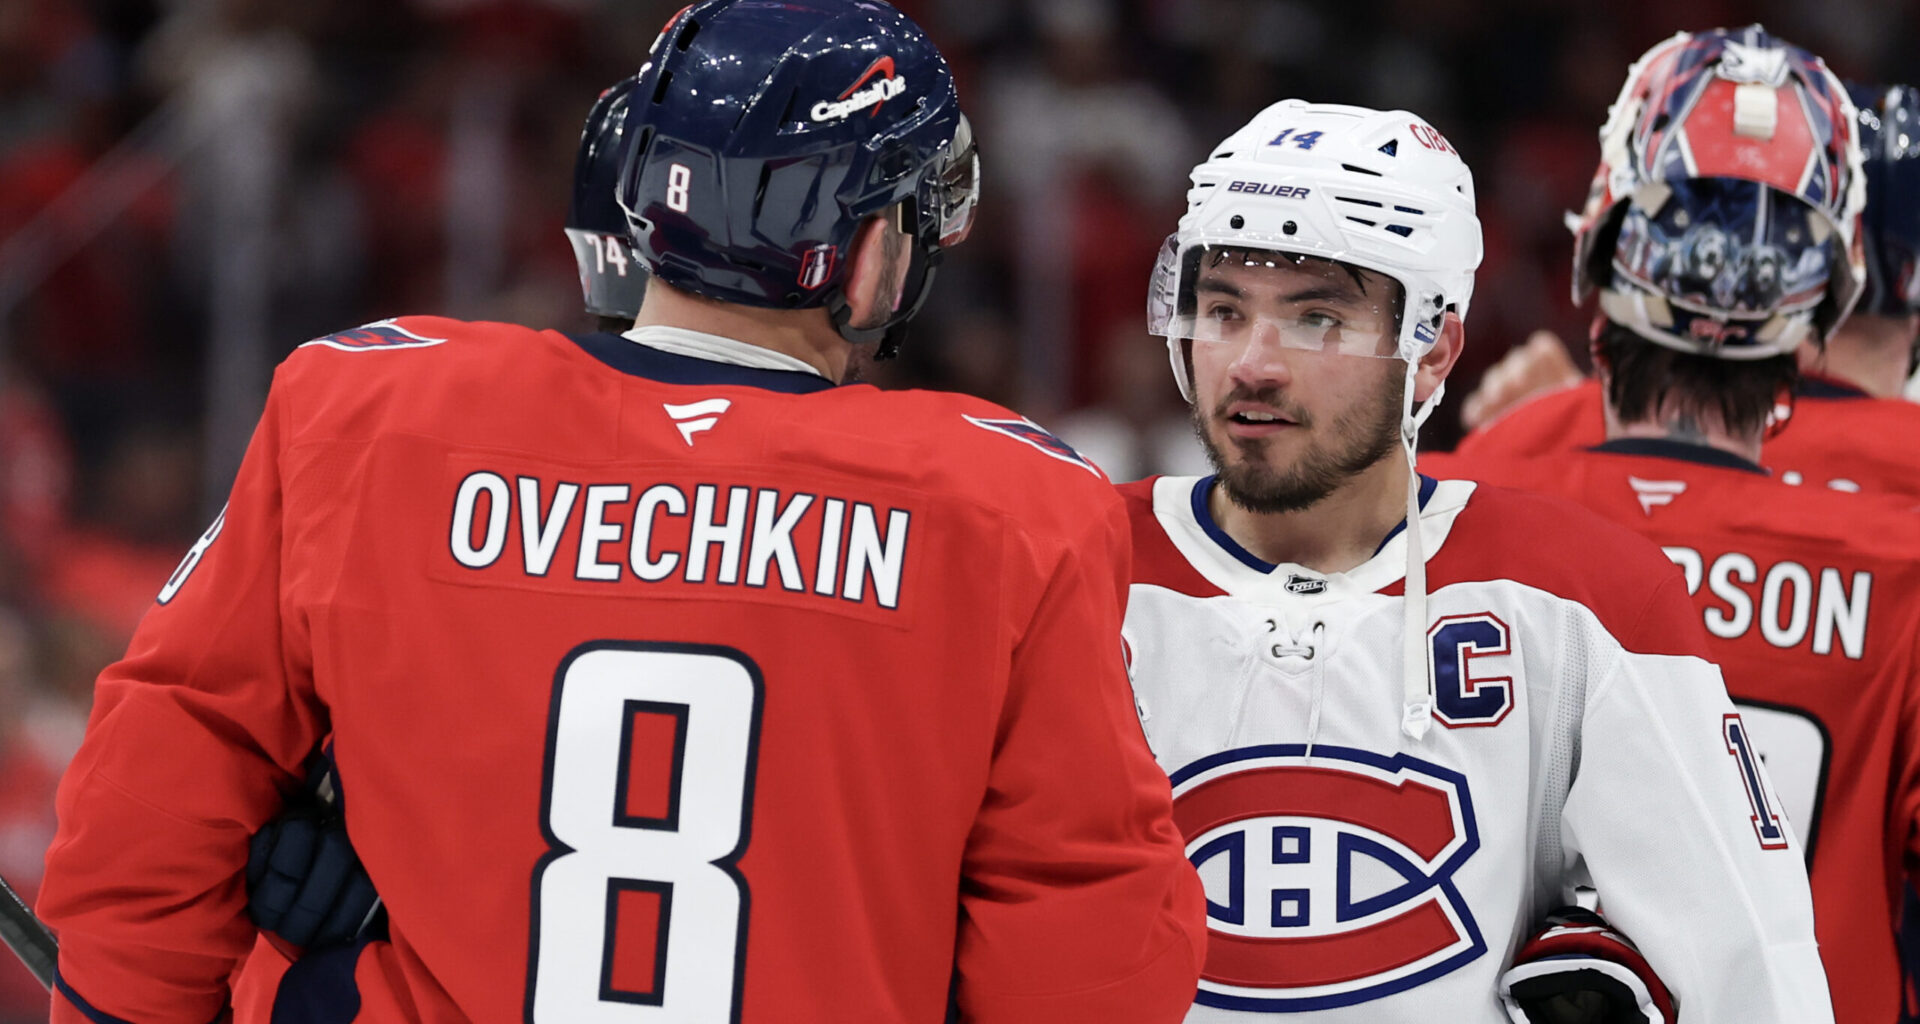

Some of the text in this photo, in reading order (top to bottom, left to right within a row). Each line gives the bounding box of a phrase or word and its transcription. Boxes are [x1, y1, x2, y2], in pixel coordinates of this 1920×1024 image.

[1267, 128, 1327, 151] 14
[666, 163, 692, 214] 8
[1227, 180, 1312, 200] BAUER
[583, 233, 628, 277] 74
[155, 499, 230, 606] 8
[448, 470, 911, 611] OVECHKIN
[1428, 611, 1515, 729] C
[523, 638, 766, 1024] 8
